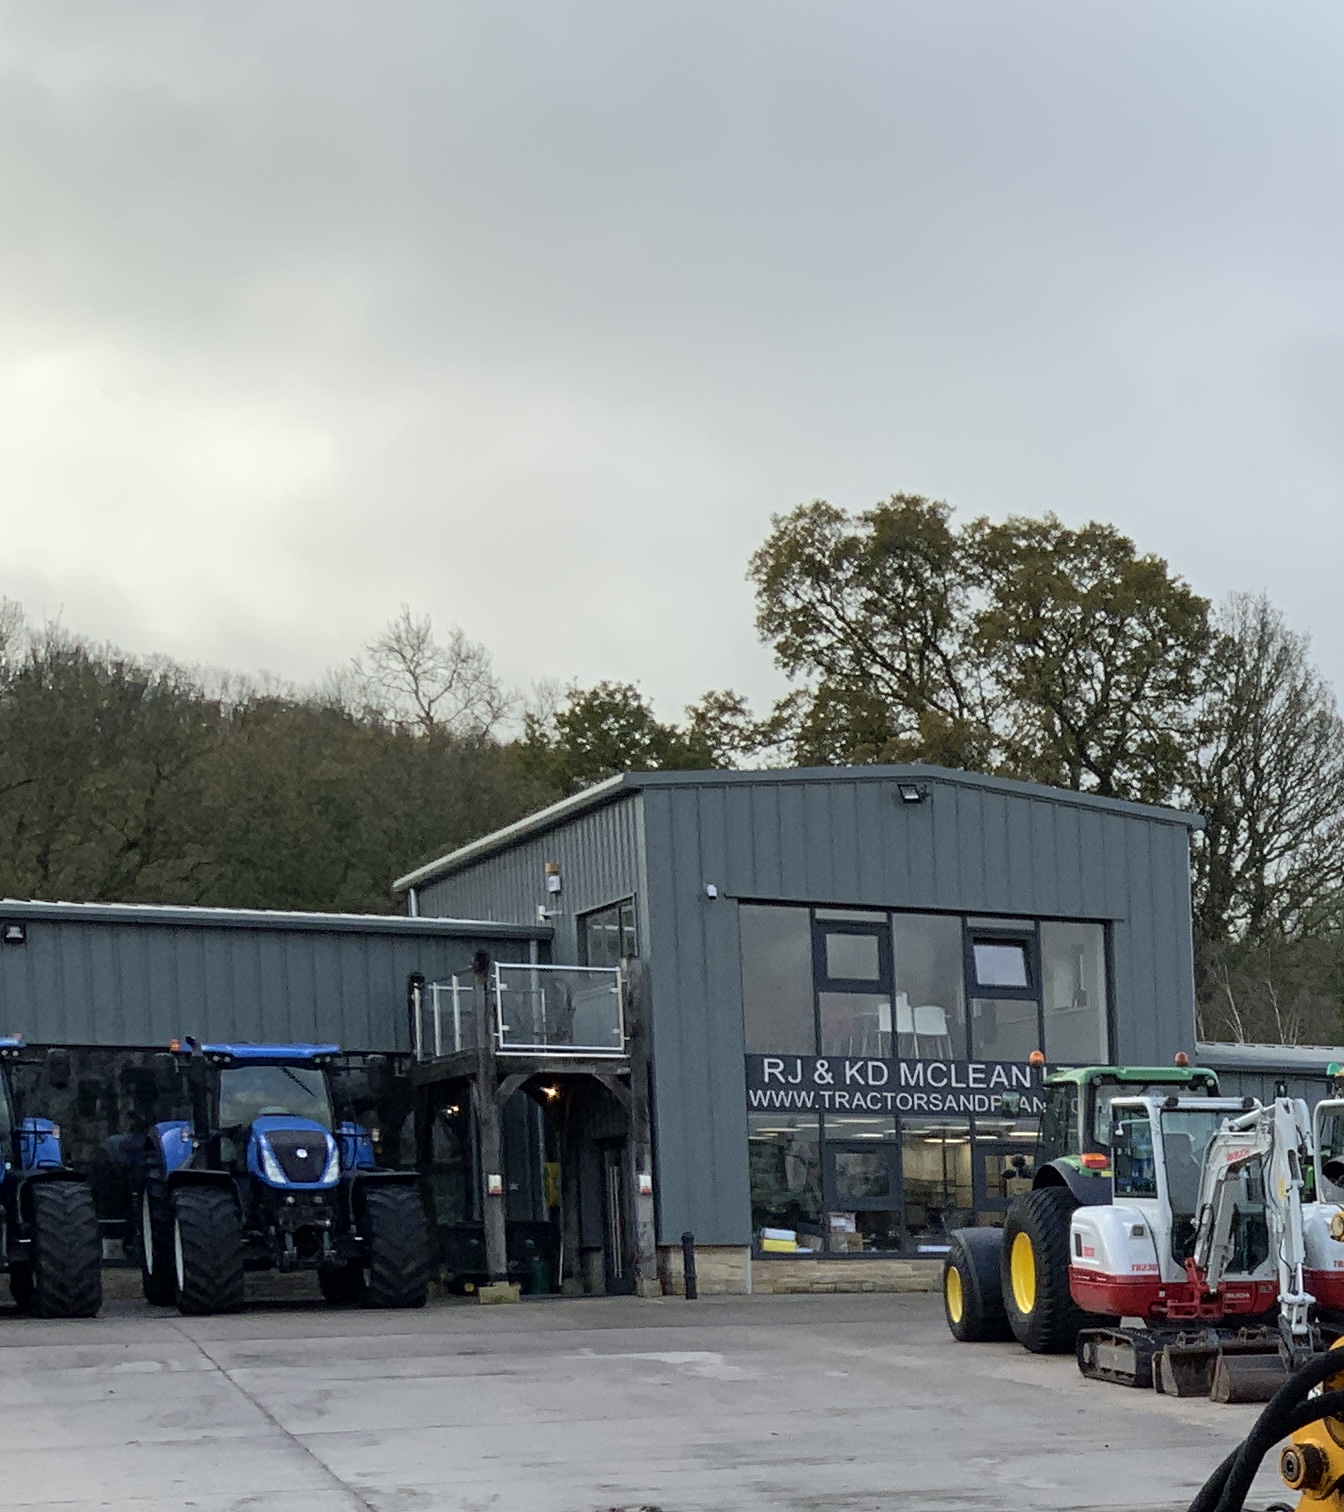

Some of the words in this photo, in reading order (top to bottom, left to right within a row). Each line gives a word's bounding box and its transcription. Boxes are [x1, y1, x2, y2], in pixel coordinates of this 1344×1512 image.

[763, 1058, 802, 1084] RJ
[814, 1059, 834, 1085] &
[845, 1060, 888, 1086] KD
[900, 1062, 1031, 1088] MCLEAN
